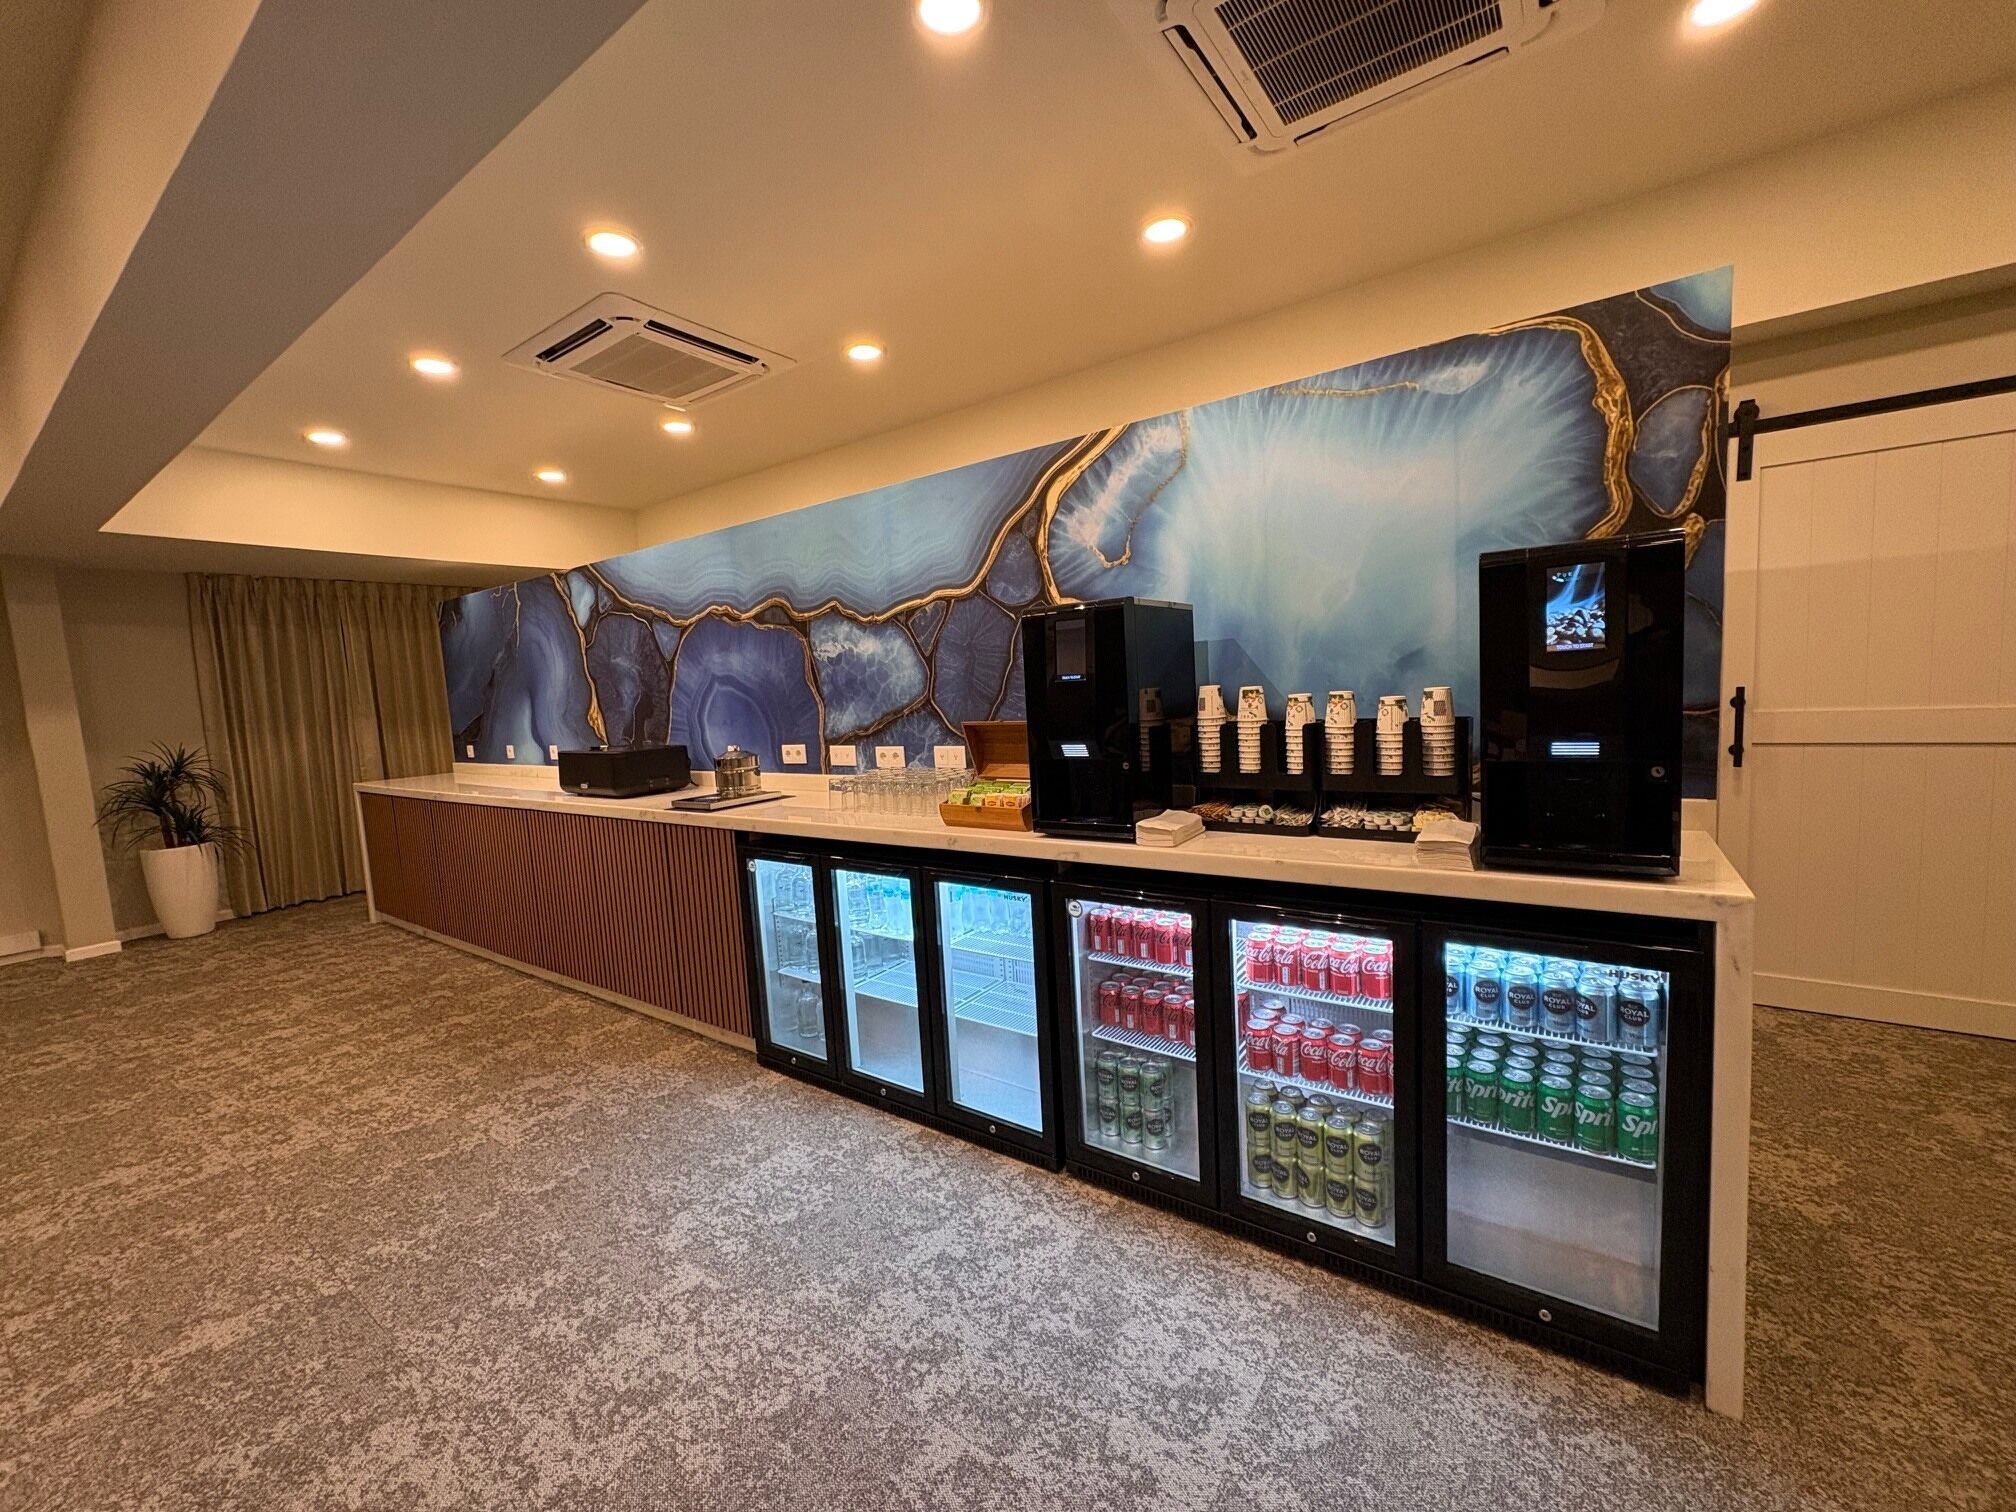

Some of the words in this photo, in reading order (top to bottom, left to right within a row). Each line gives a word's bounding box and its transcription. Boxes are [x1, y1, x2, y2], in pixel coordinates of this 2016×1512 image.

[1003, 894, 1027, 902] HUSKY
[1608, 968, 1660, 983] HUSKY
[1475, 985, 1499, 994] ROYAL
[1508, 990, 1535, 1000] ROYAL
[1543, 994, 1571, 1006] ROYAL
[1620, 1004, 1650, 1019] ROYAL
[1624, 1014, 1643, 1022] CLUB
[1327, 1140, 1349, 1150] ROYAL
[1359, 1147, 1381, 1157] ROYAL
